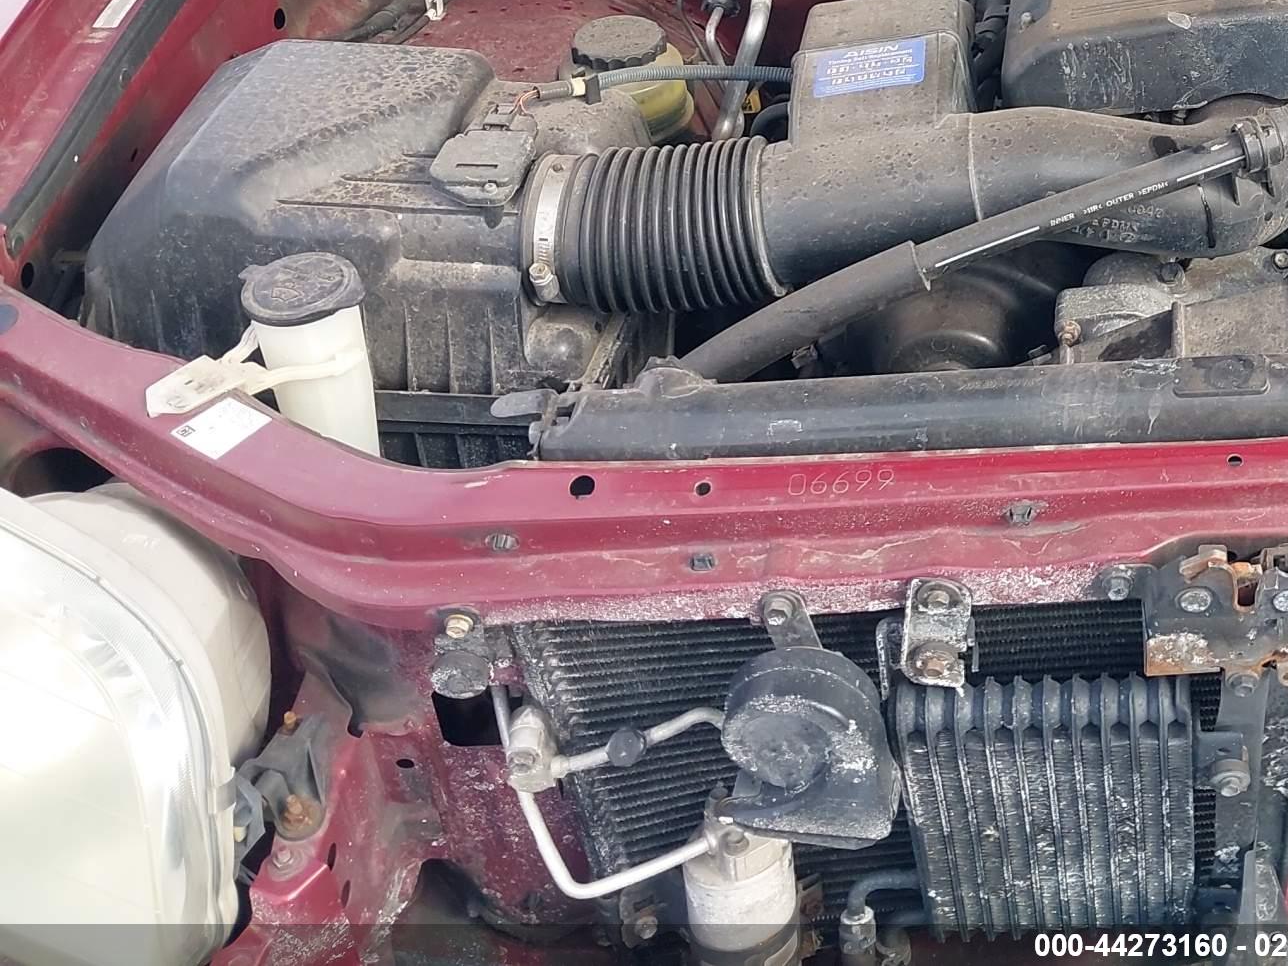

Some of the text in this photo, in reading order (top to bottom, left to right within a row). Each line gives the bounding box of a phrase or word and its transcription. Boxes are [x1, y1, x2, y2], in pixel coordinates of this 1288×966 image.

[843, 44, 899, 59] AISIN
[1106, 192, 1135, 207] OUTER
[788, 468, 896, 496] 06699
